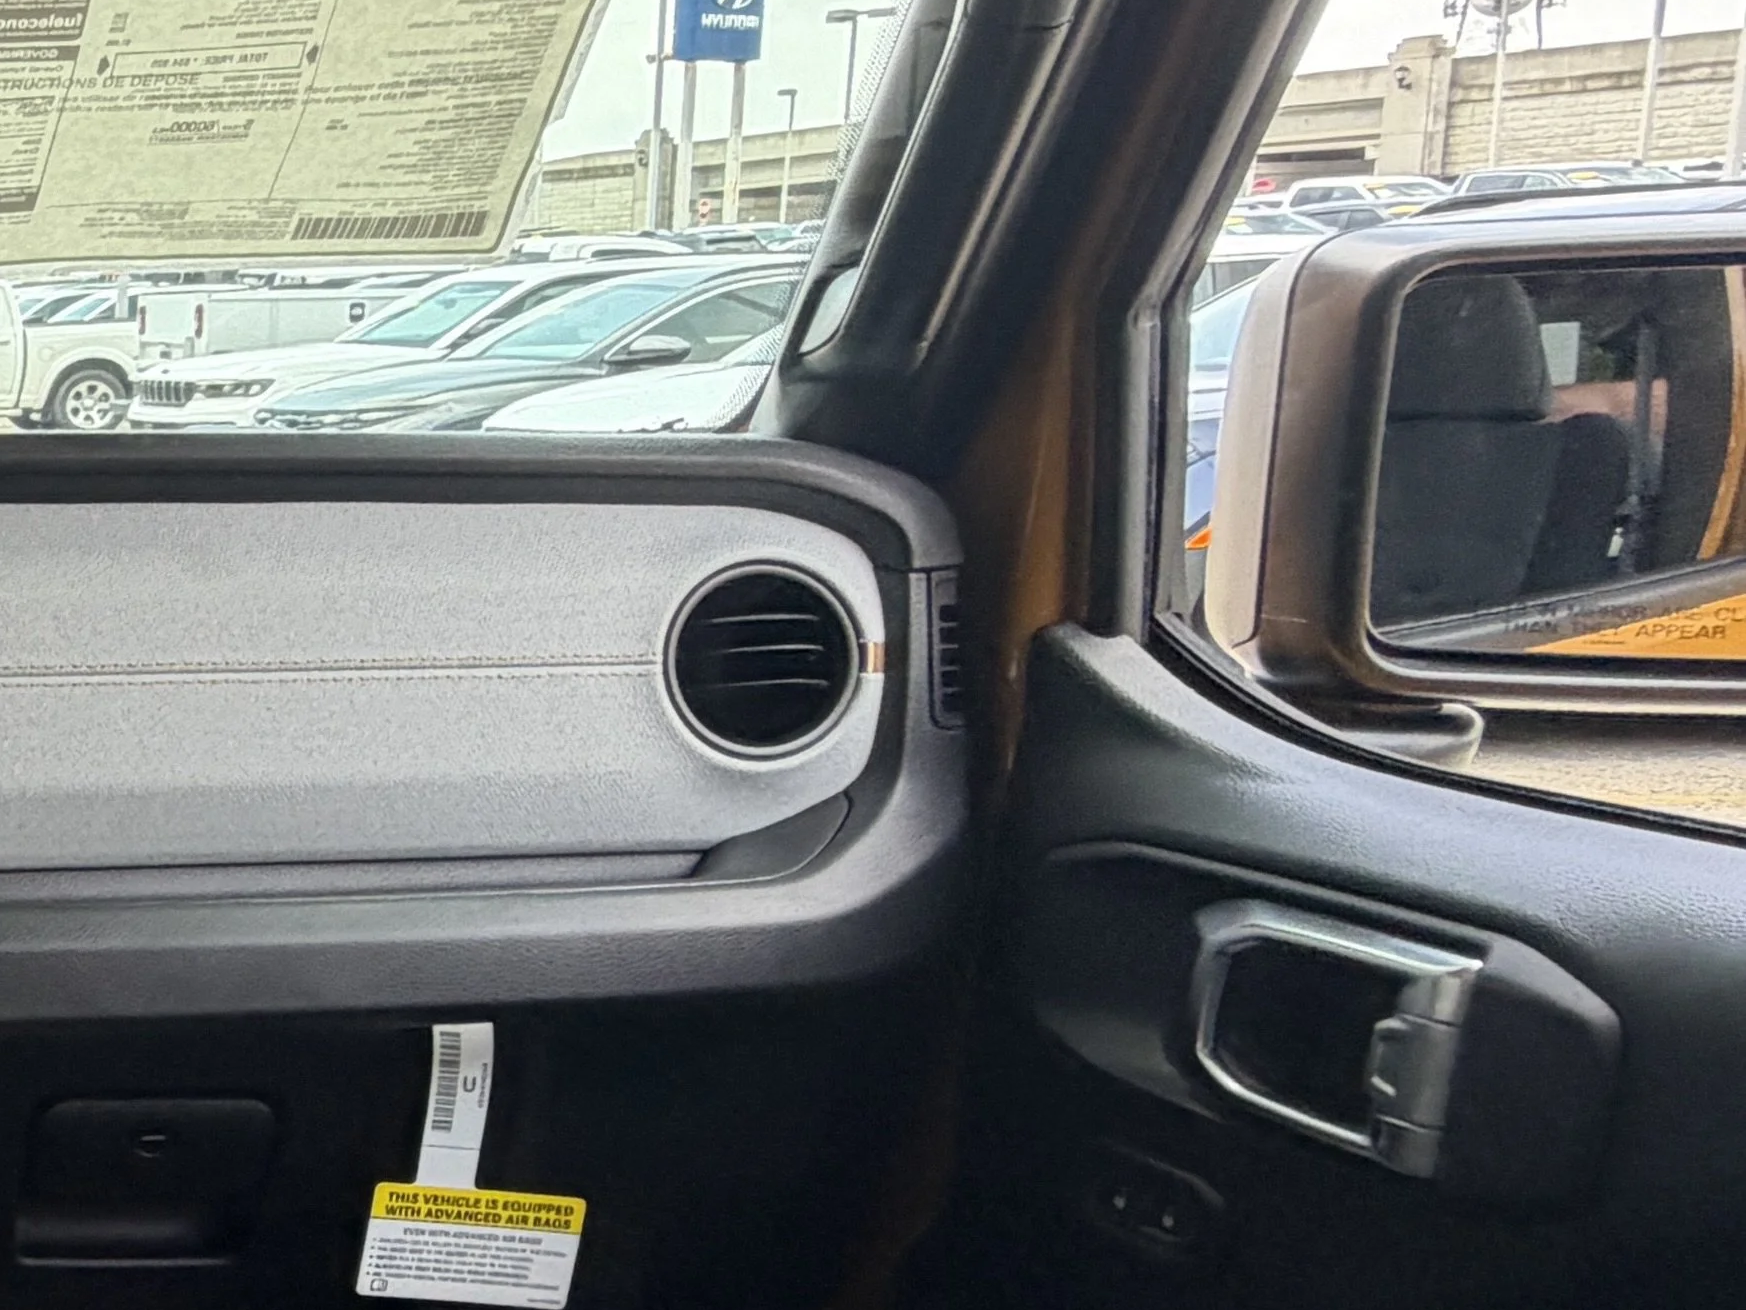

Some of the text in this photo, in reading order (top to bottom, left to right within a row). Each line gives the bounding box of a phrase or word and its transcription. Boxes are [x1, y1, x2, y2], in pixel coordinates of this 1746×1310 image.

[701, 12, 760, 30] HYUNDAI
[130, 74, 201, 88] DEPOSE
[1634, 623, 1726, 639] APPEAR
[388, 1191, 574, 1217] THIS VEHICLE IS EQUIPPED
[384, 1204, 571, 1229] WITH ADVANCED AIR BAGS
